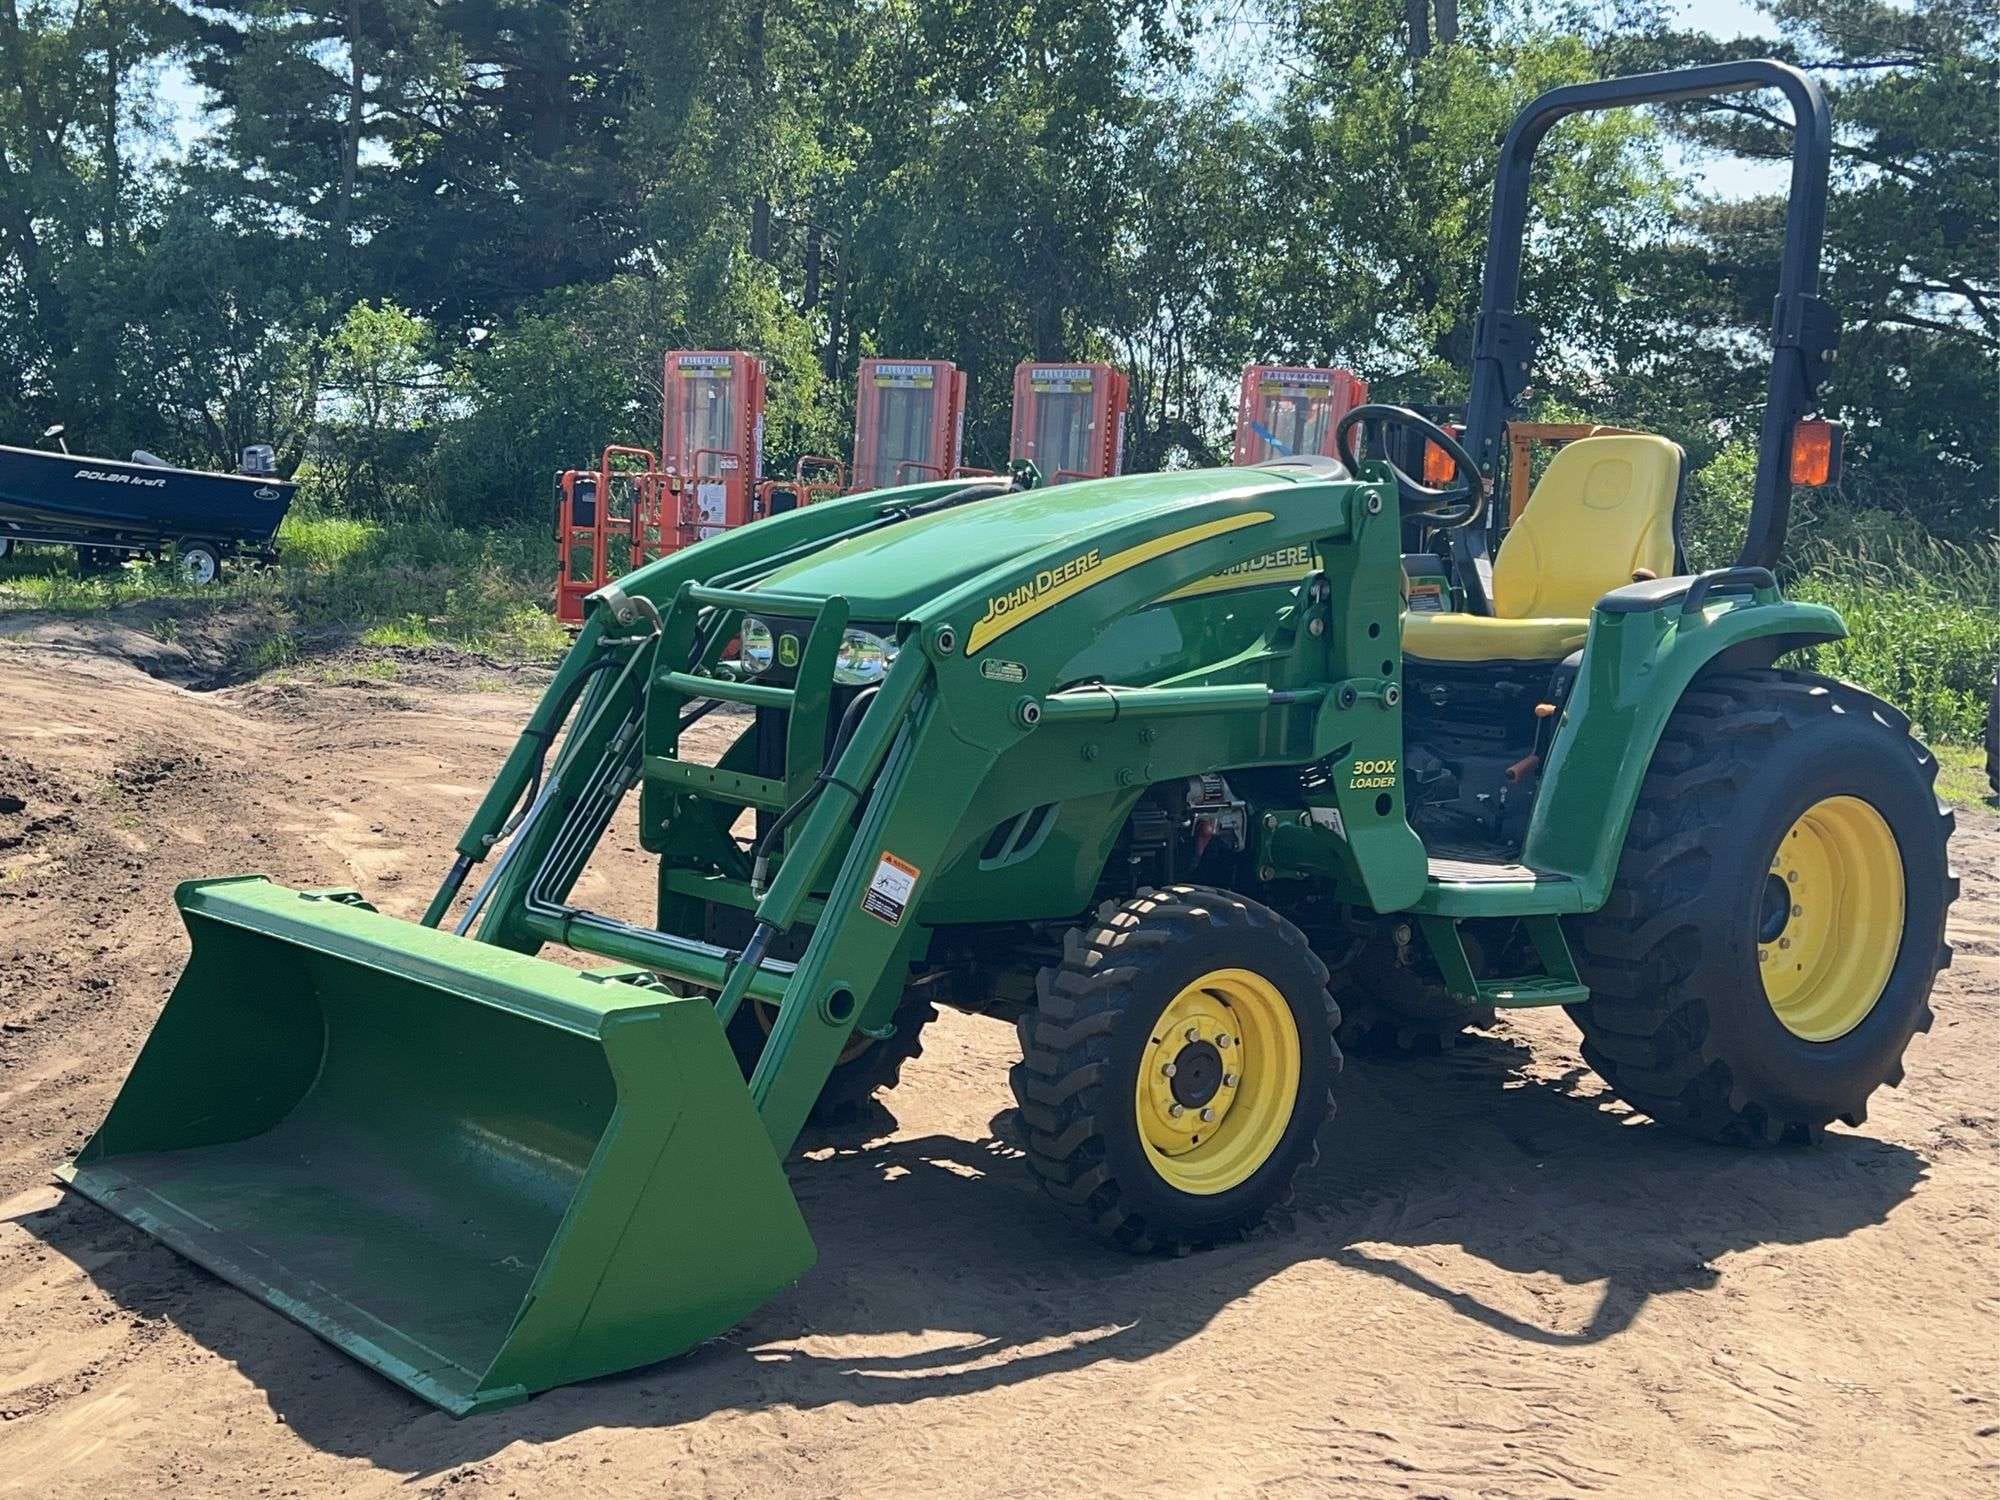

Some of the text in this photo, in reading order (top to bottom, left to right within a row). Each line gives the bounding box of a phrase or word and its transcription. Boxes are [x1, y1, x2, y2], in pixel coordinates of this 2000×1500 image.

[983, 548, 1101, 623] JOHN DEERE
[1353, 759, 1397, 775] 300X
[1349, 777, 1396, 789] LOADER
